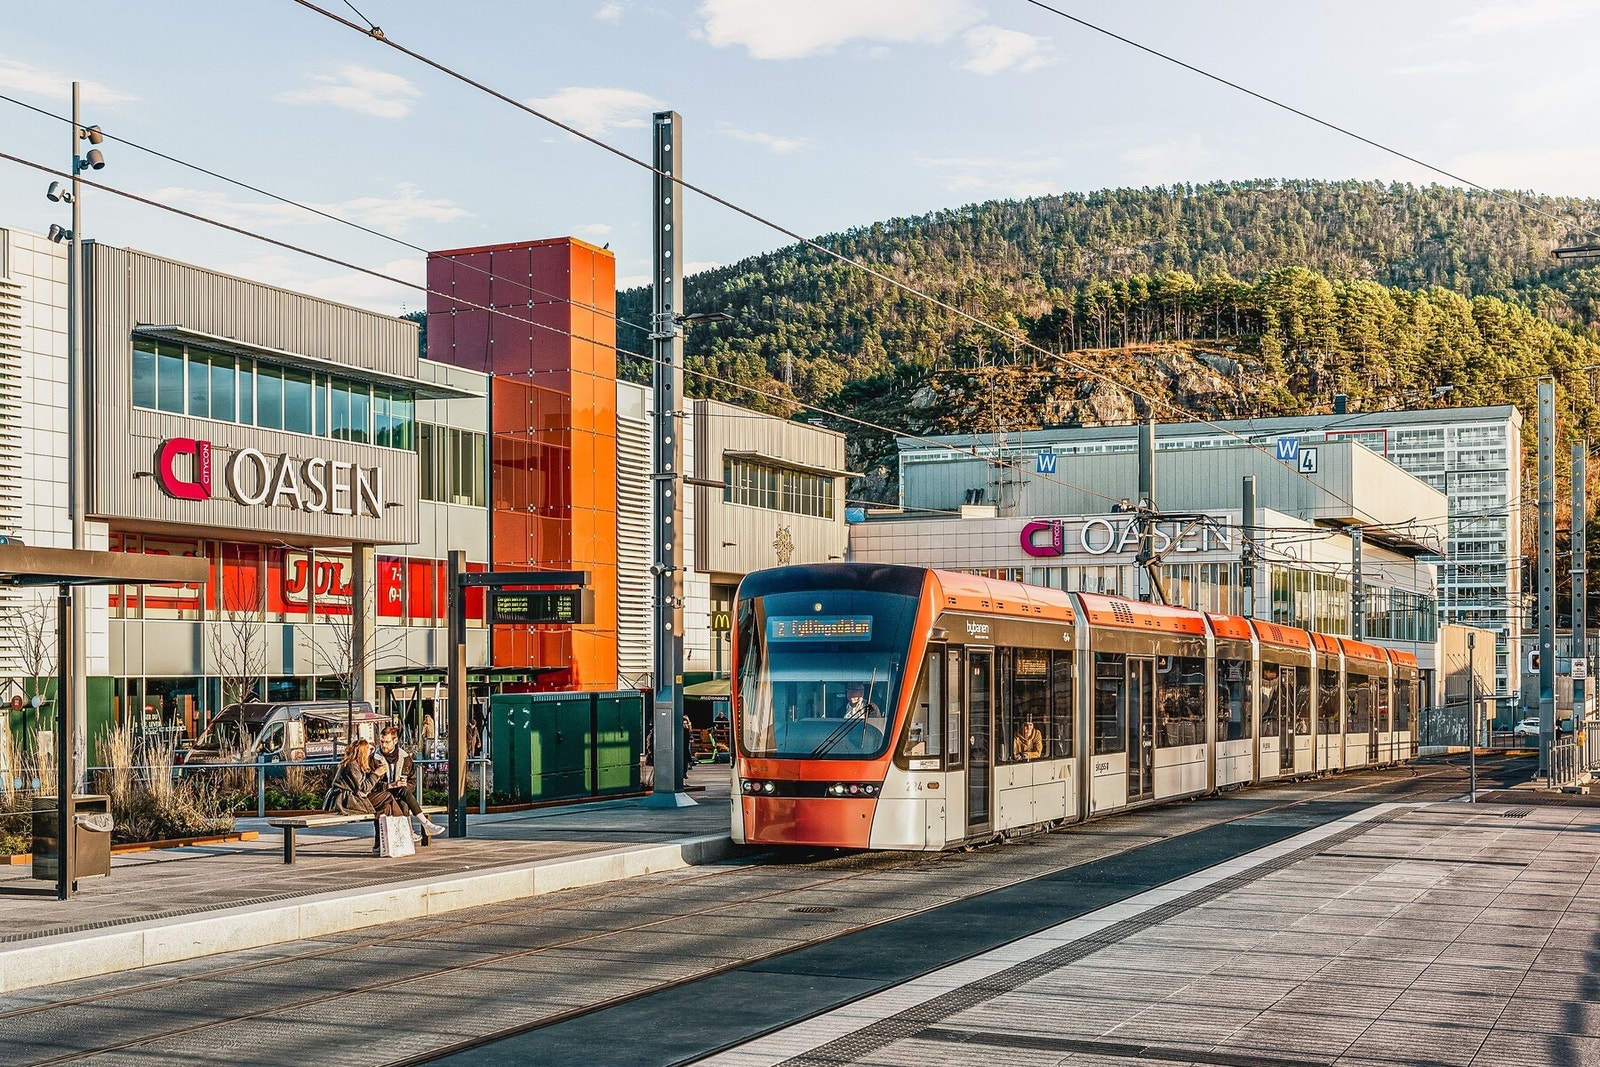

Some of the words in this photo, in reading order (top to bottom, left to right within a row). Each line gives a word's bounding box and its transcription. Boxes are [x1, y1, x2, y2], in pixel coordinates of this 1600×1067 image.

[1278, 442, 1298, 458] W
[1038, 456, 1056, 472] W
[1301, 451, 1314, 470] 4
[232, 448, 383, 519] OASEN
[1053, 520, 1061, 547] CITYCON
[1080, 514, 1233, 555] OASEN
[778, 622, 785, 636] 2
[792, 619, 869, 637] Fyllingsdalen
[966, 619, 989, 635] bybanen
